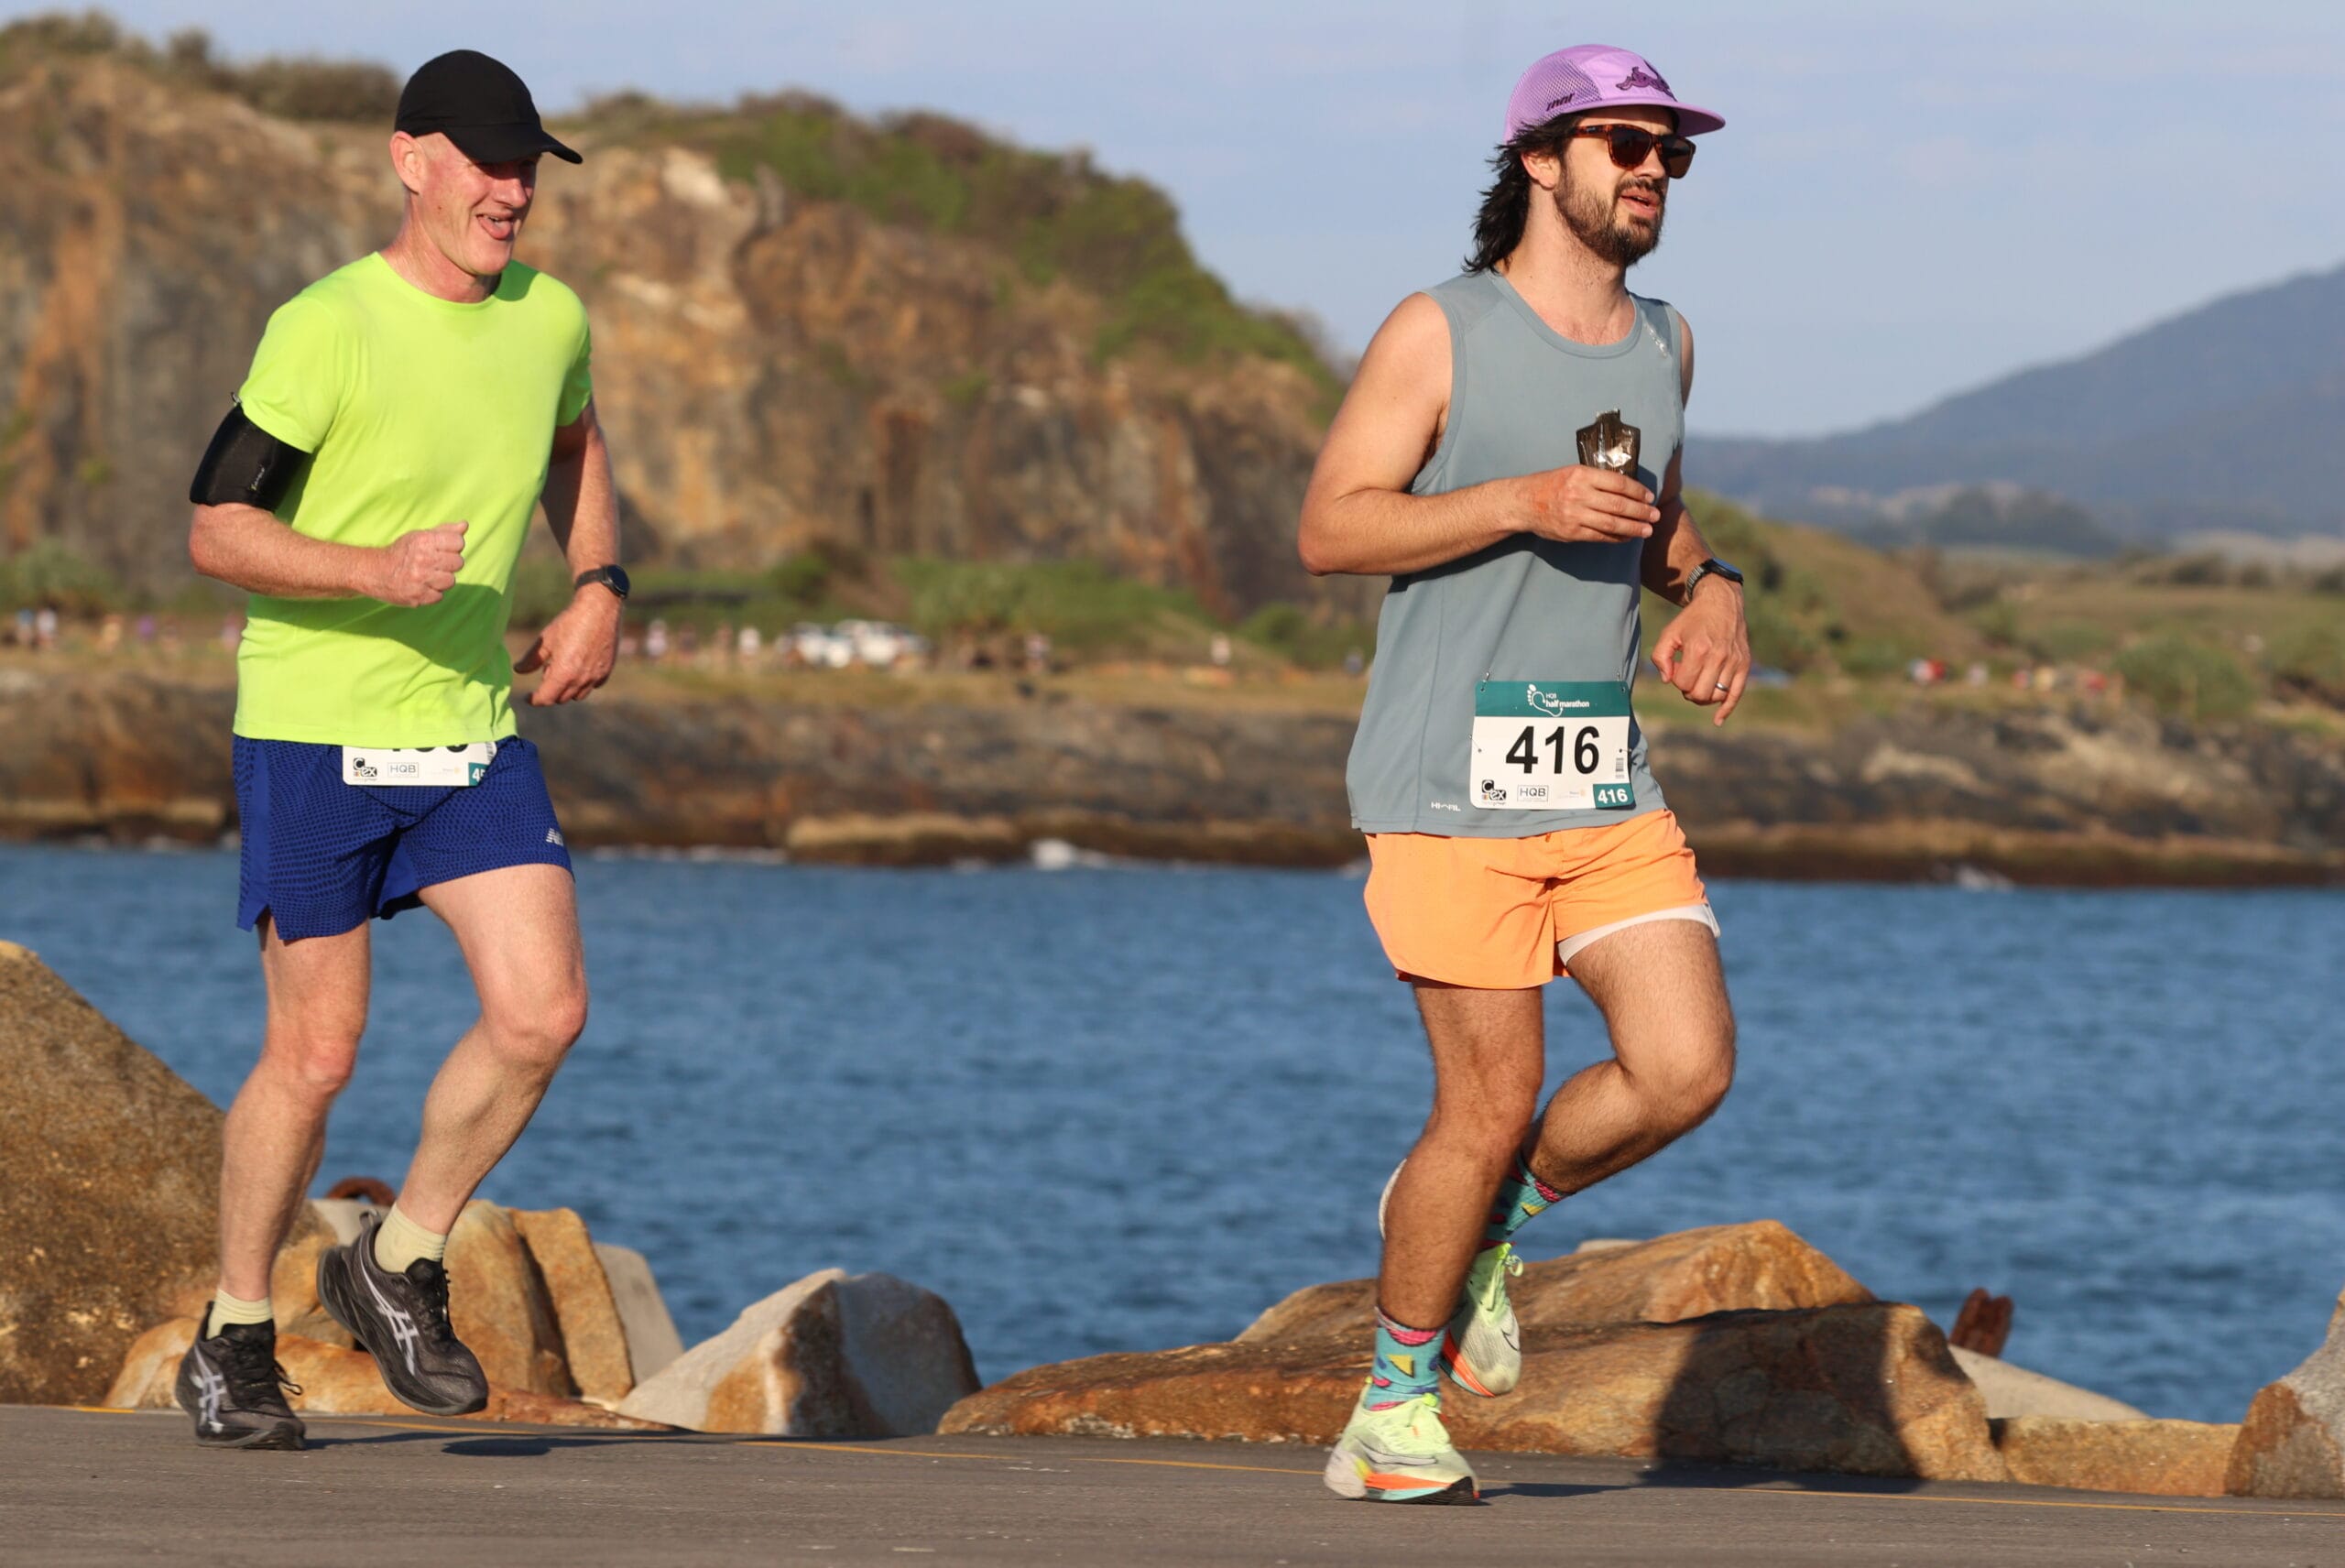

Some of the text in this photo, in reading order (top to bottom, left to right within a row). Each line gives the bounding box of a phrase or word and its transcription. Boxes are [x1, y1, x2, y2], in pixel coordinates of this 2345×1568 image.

[1545, 699, 1590, 708] half marathon
[1505, 725, 1599, 775] 416
[390, 764, 417, 773] HQB
[1519, 787, 1546, 797] HQB
[1598, 788, 1629, 804] 416
